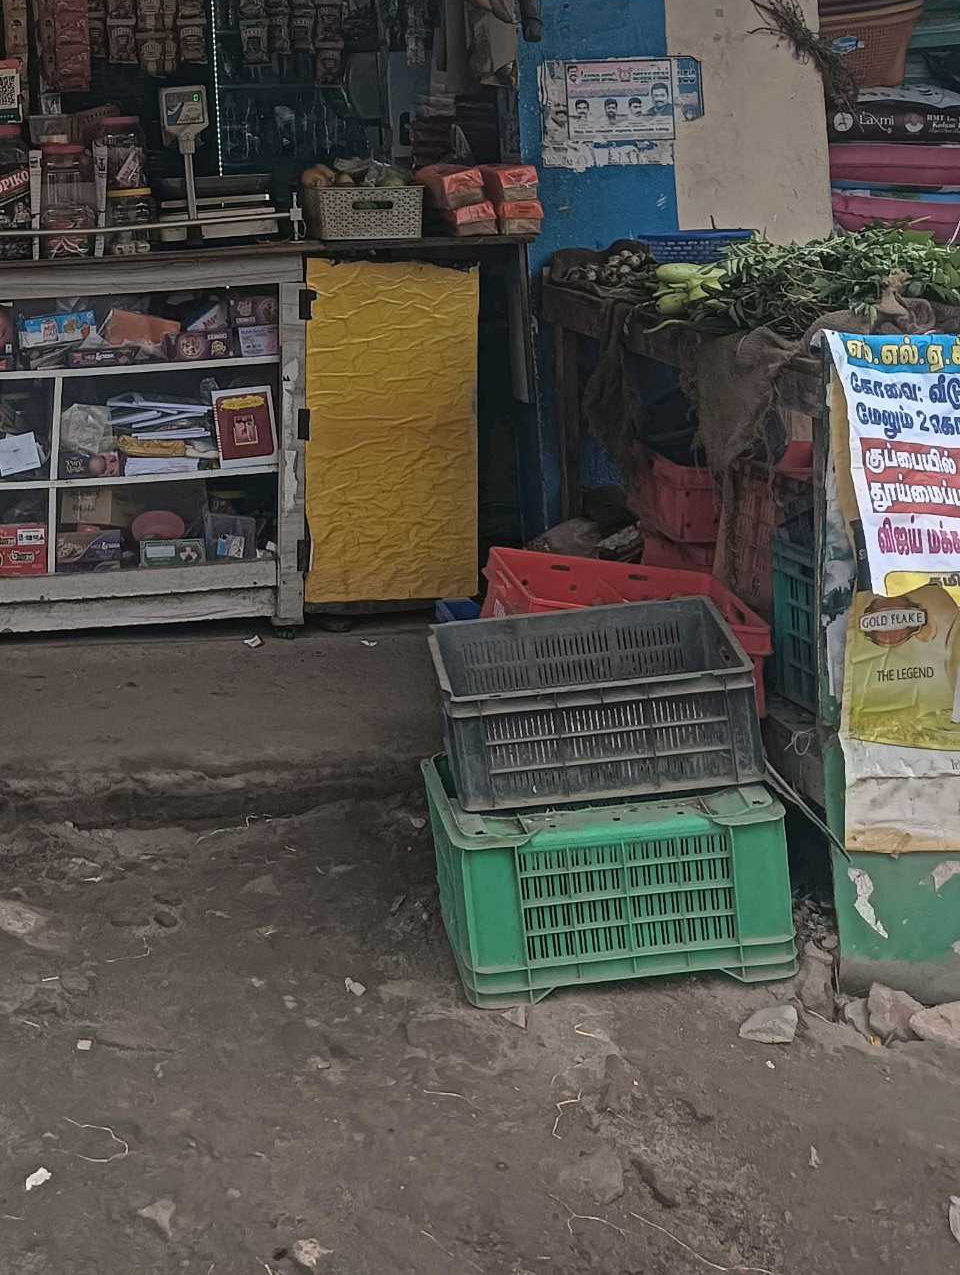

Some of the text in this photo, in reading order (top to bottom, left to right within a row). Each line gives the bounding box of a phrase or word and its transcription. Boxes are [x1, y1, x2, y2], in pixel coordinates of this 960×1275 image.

[856, 402, 914, 439] மேலும்
[878, 515, 924, 555] விஜய்
[862, 612, 923, 630] GOLD FLAKE
[876, 667, 934, 682] THE LEGEND
